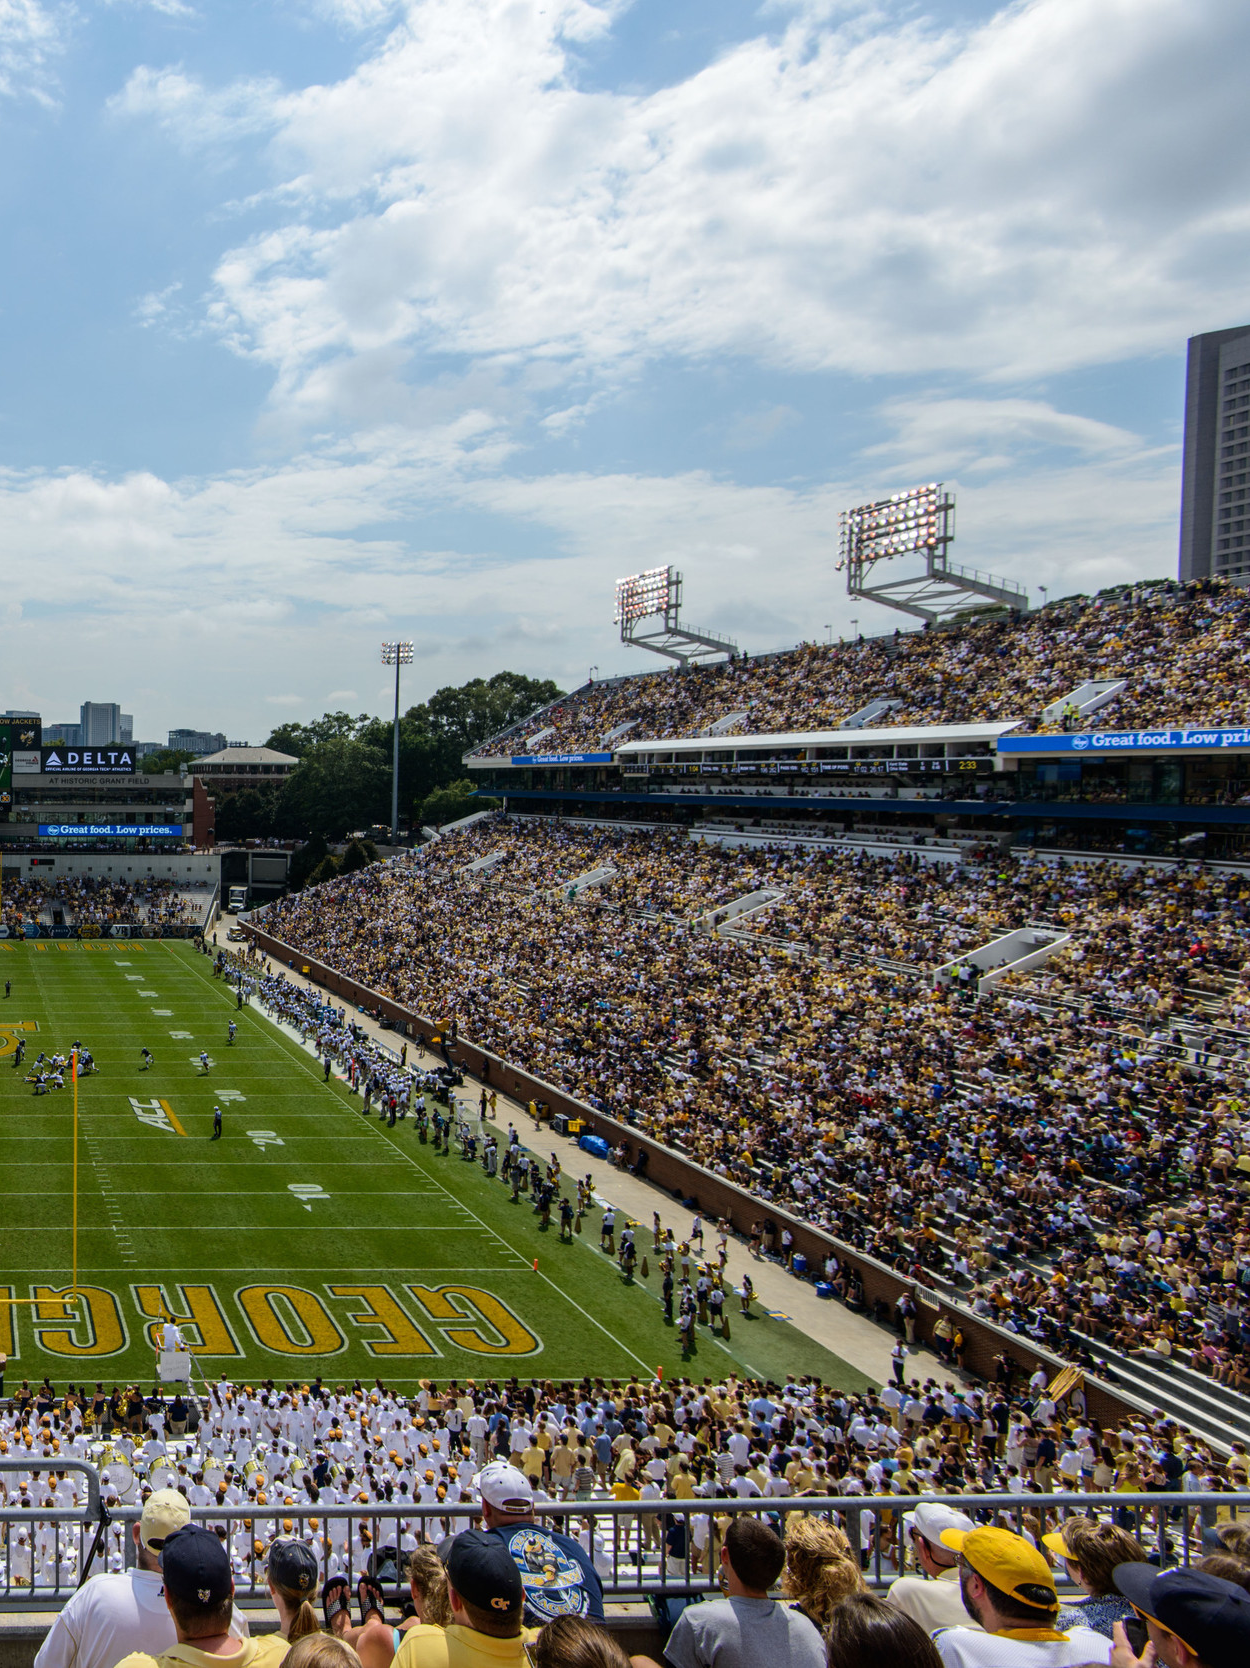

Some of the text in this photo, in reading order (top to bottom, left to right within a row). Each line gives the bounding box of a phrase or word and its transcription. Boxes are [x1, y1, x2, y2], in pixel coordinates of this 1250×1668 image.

[1092, 729, 1250, 747] Great food. Low pri
[67, 752, 132, 765] DELTA
[959, 761, 977, 770] 2:33
[60, 825, 173, 835] Great food. Low prices.
[25, 943, 147, 952] TECH
[213, 1089, 247, 1102] 30
[127, 1096, 177, 1134] ACC
[246, 1130, 286, 1146] 20
[287, 1183, 331, 1201] 10
[490, 1597, 510, 1611] GT
